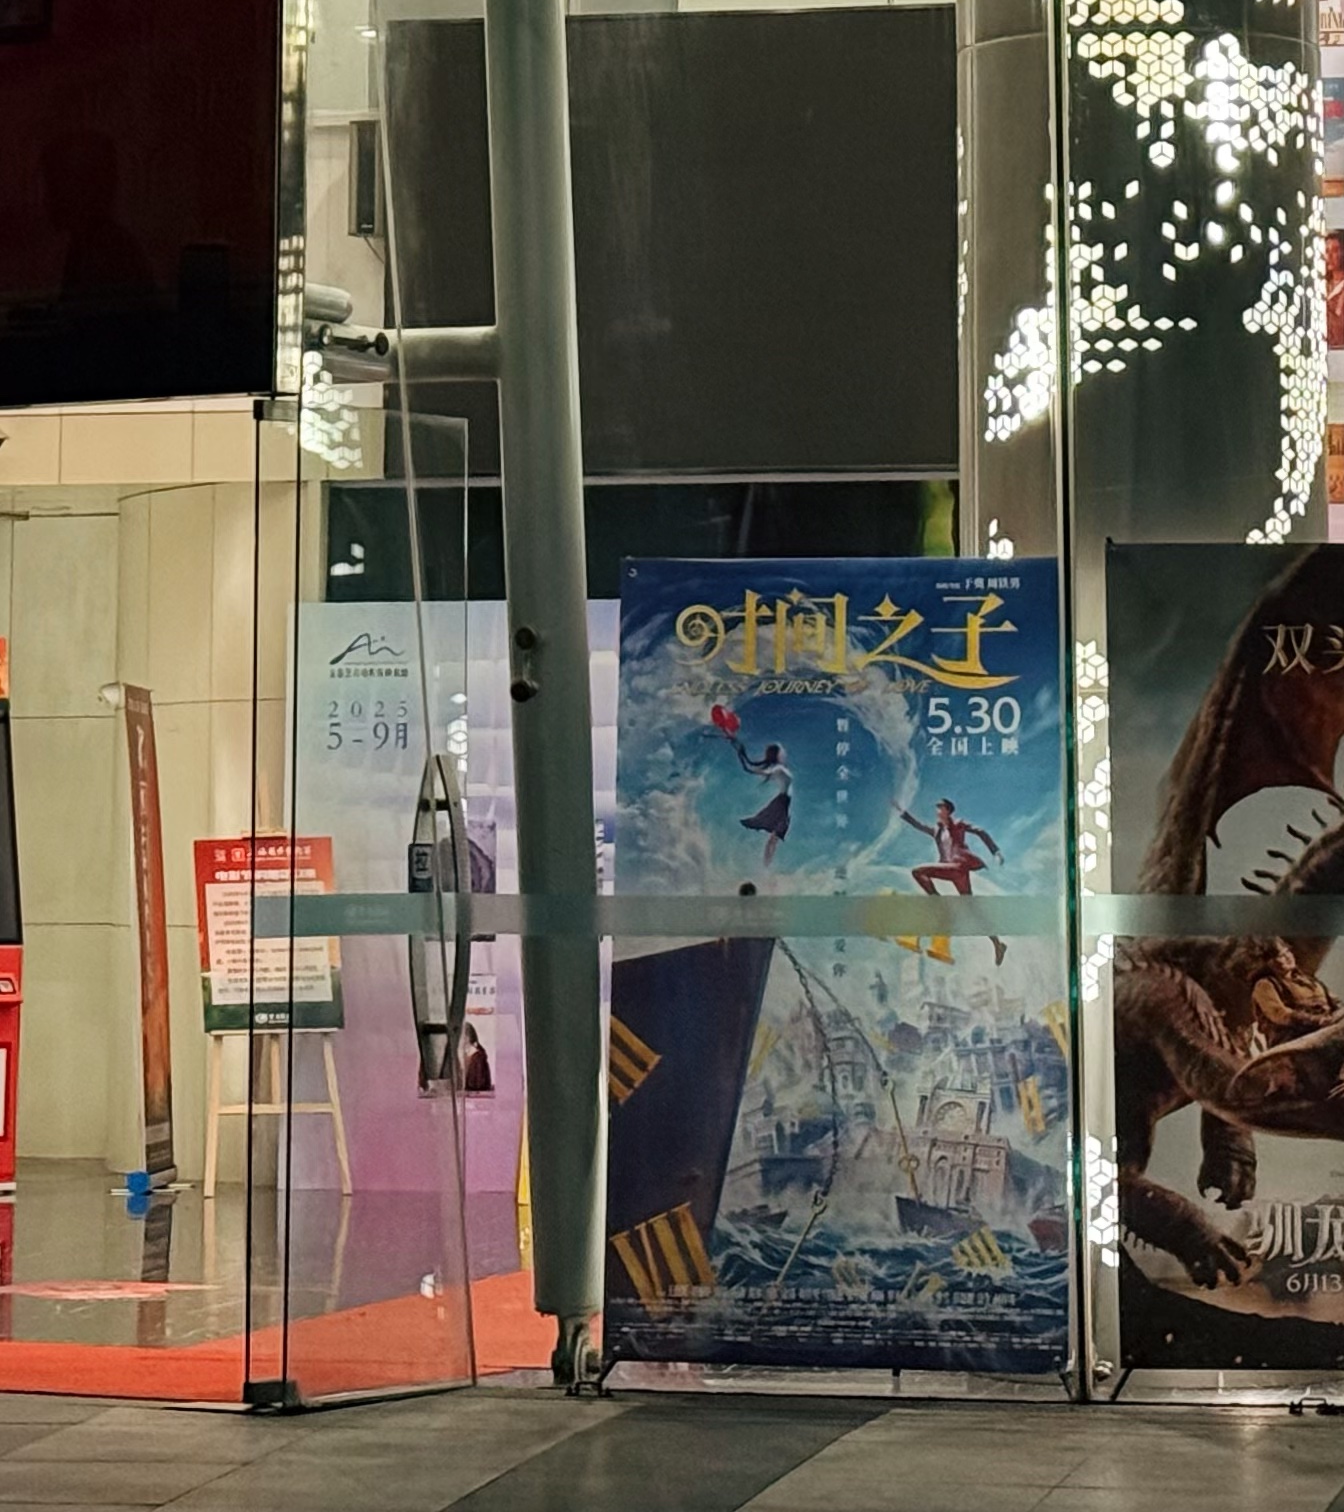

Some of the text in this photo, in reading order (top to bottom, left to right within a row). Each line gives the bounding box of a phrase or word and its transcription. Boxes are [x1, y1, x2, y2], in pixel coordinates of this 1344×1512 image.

[674, 587, 1022, 689] 时间之子
[755, 679, 838, 695] JOURNEY
[926, 696, 1022, 735] 5.30
[926, 736, 1020, 757] 全国上映
